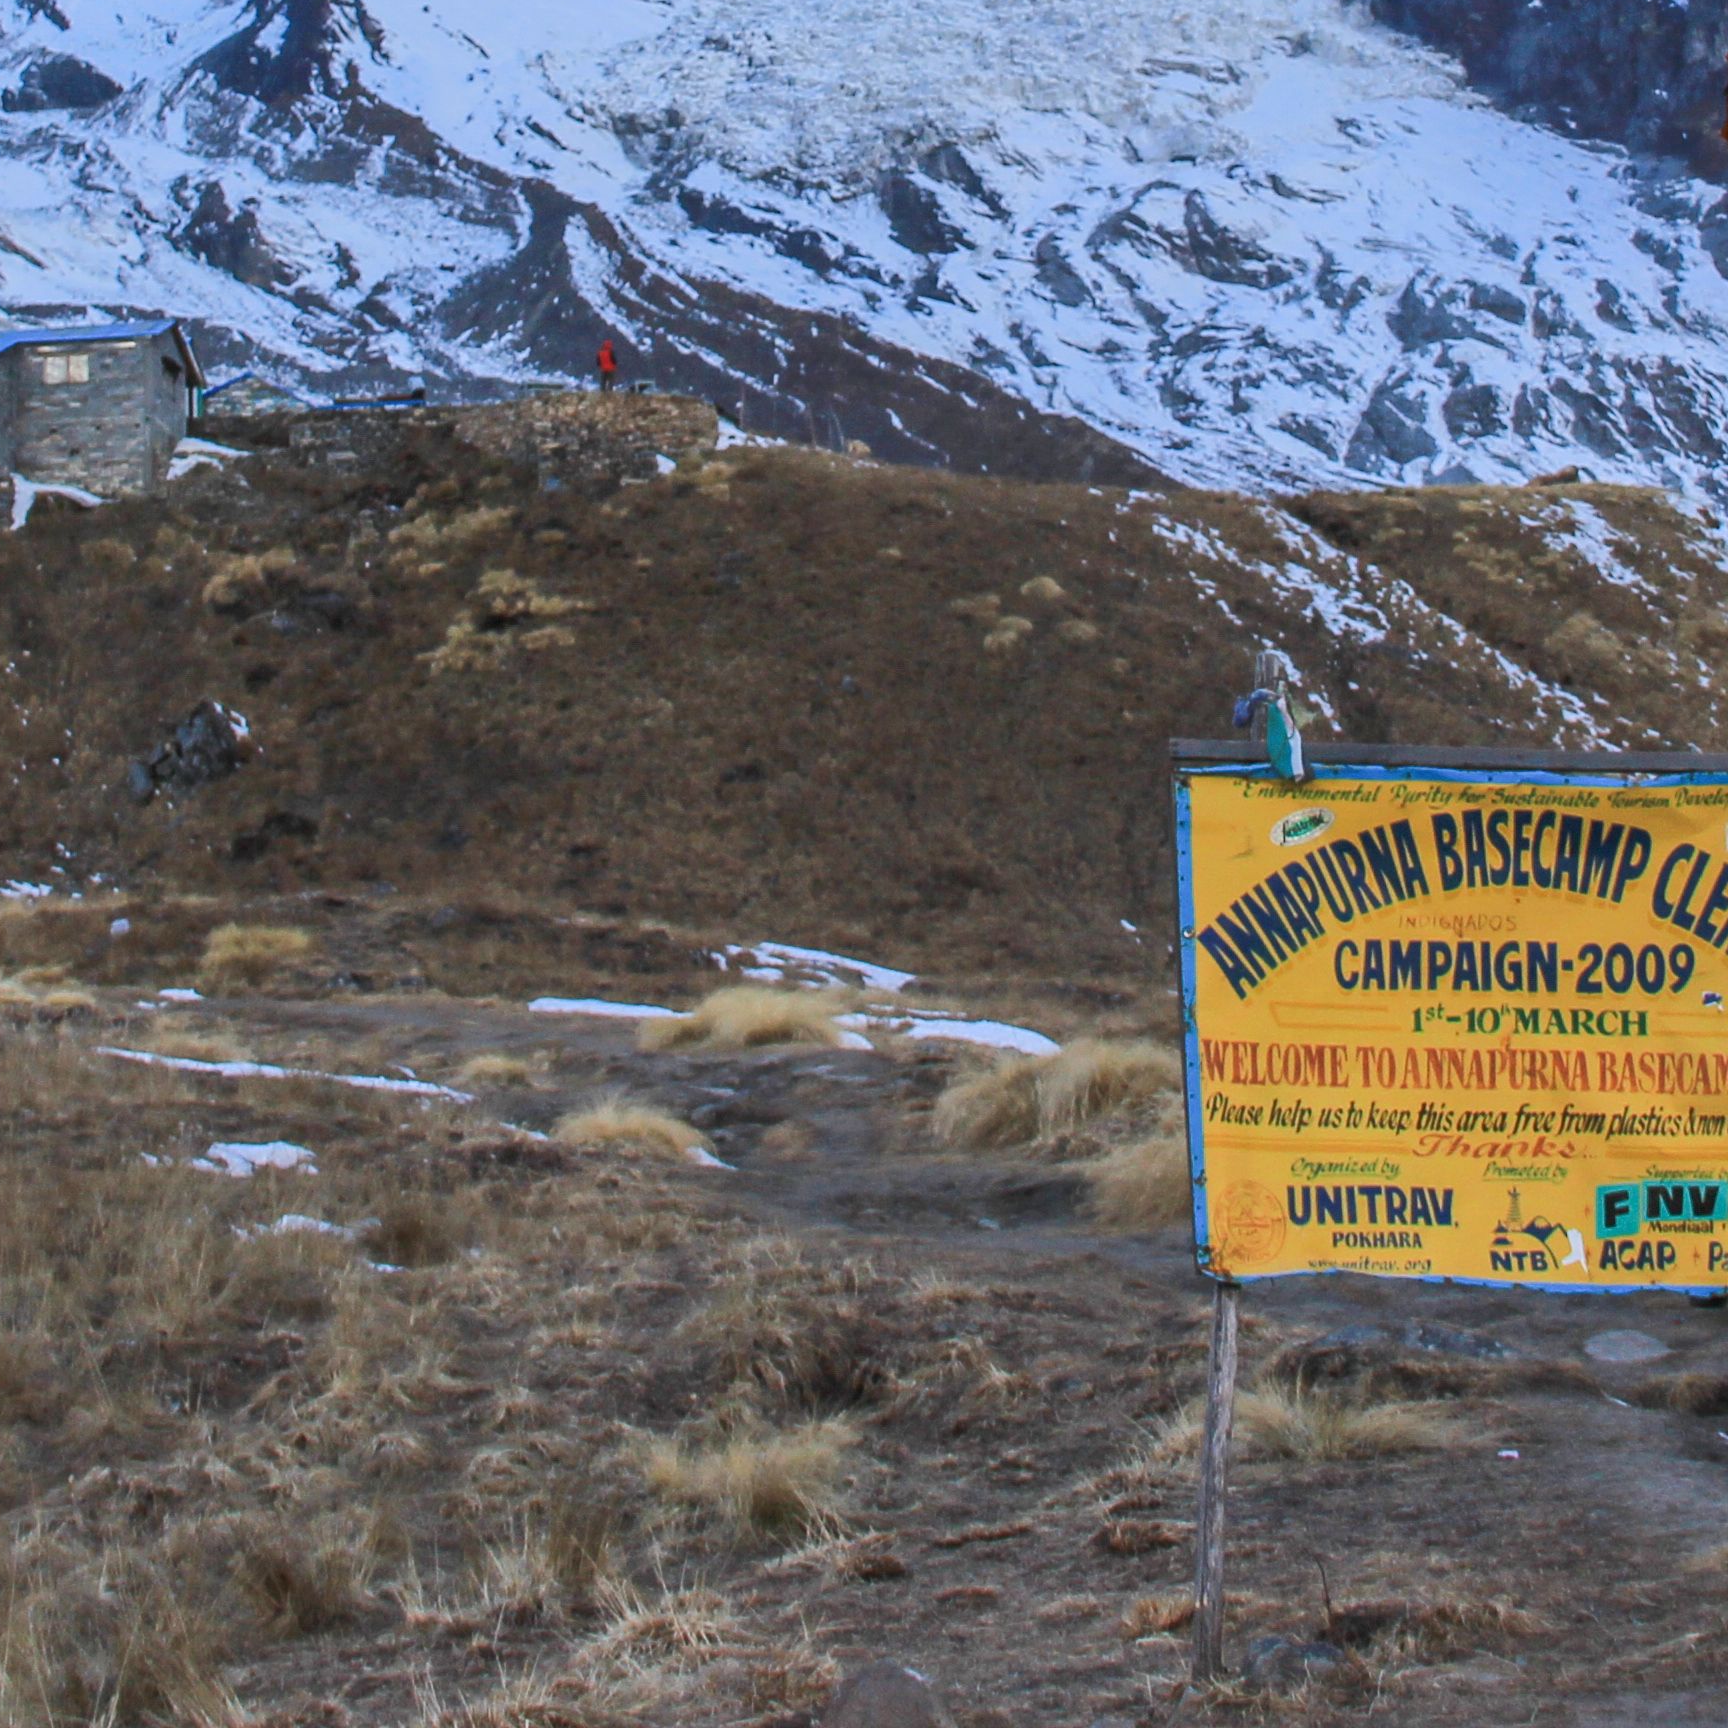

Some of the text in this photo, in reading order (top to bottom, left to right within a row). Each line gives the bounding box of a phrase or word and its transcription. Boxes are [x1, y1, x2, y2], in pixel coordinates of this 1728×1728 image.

[1390, 785, 1452, 808] Purity
[1490, 786, 1601, 809] Sustainable
[1607, 789, 1671, 809] Tourism
[1196, 818, 1430, 1001] ANNAPURNA
[1431, 809, 1652, 904] BASECAMP
[1398, 914, 1518, 934] INDIGNADOS
[1333, 939, 1696, 995] CAMPAIGN-2009
[1512, 1007, 1649, 1037] MARCH
[1201, 1038, 1349, 1089] WELCOME
[1355, 1045, 1397, 1089] TO
[1399, 1046, 1591, 1092] ANNAPURNA
[1206, 1091, 1264, 1128] Please
[1268, 1098, 1312, 1133] help
[1318, 1106, 1342, 1129] us
[1346, 1100, 1363, 1129] to
[1368, 1101, 1411, 1136] keep
[1415, 1102, 1454, 1132] this
[1455, 1110, 1508, 1134] area
[1511, 1103, 1556, 1137] free
[1556, 1103, 1606, 1136] from
[1605, 1106, 1681, 1141] plastics
[1290, 1156, 1401, 1181] Organized by
[1483, 1160, 1569, 1181] Promoted by
[1644, 1164, 1714, 1183] Supported
[1332, 1230, 1423, 1250] POKHARA
[1489, 1249, 1548, 1272] NTB
[1598, 1239, 1677, 1272] ACAP
